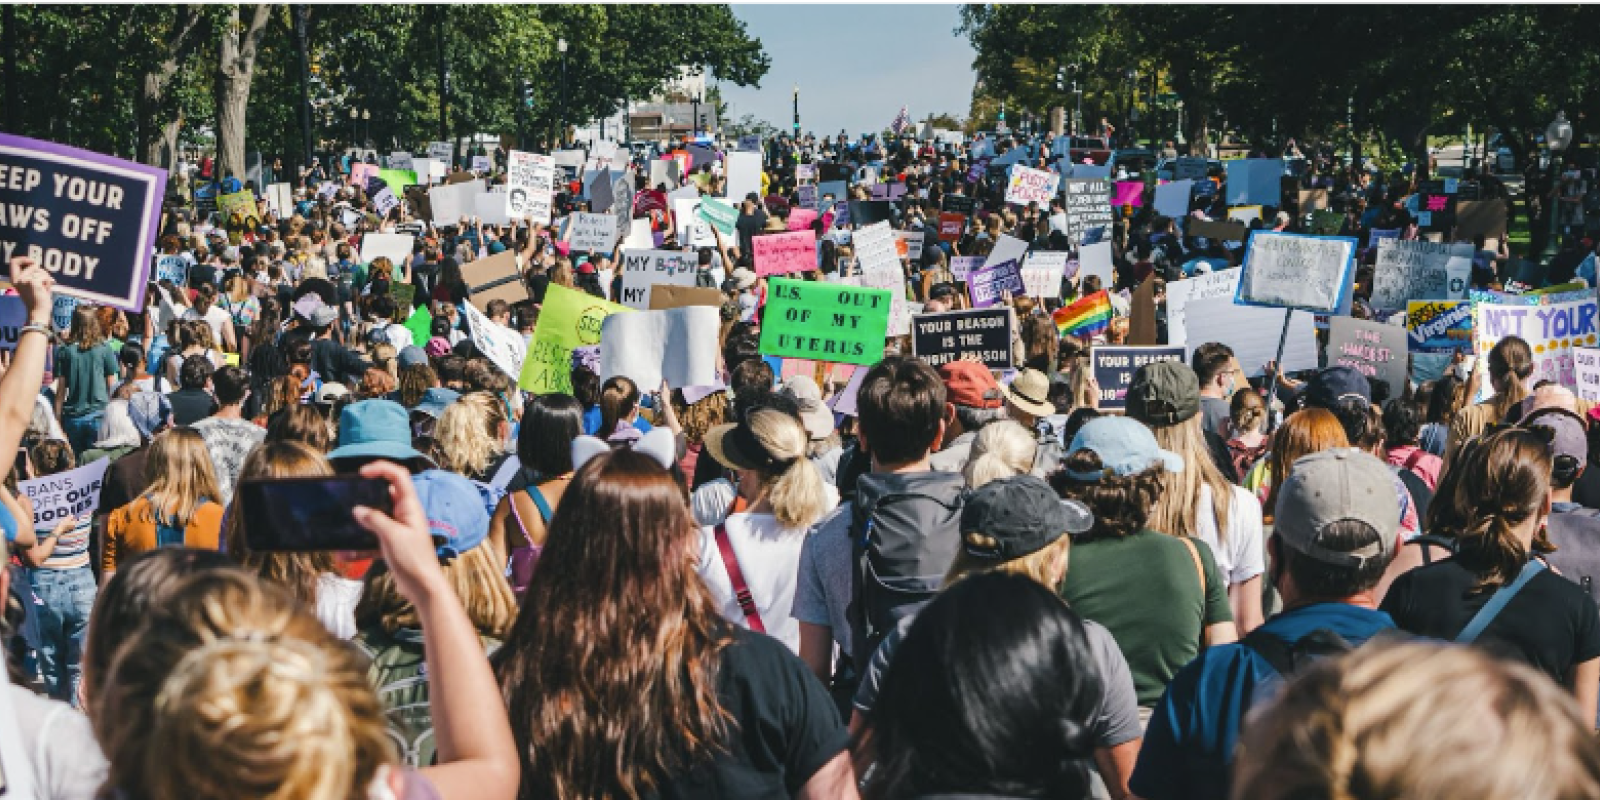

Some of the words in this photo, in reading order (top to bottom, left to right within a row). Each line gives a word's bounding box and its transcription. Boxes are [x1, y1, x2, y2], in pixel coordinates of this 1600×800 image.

[53, 172, 124, 210] YOUR
[61, 213, 113, 244] OFF
[27, 243, 100, 280] BODY
[626, 256, 650, 271] MY
[624, 287, 646, 302] MY
[838, 291, 882, 308] OUT
[786, 307, 812, 323] OF
[831, 313, 861, 329] MY
[919, 320, 952, 335] YOUR
[956, 316, 1005, 330] REASON
[1486, 309, 1527, 338] NOT
[1535, 303, 1598, 339] YOUR
[778, 334, 865, 355] UTERUS
[942, 335, 955, 348] IS
[959, 333, 984, 347] THE
[1354, 329, 1380, 343] THE
[960, 350, 1007, 363] REASON
[1098, 355, 1130, 368] YOUR
[1344, 342, 1391, 362] HARDEST
[1119, 372, 1132, 384] IS
[27, 477, 74, 497] BANS
[32, 494, 62, 511] OFF
[66, 479, 102, 503] OUR
